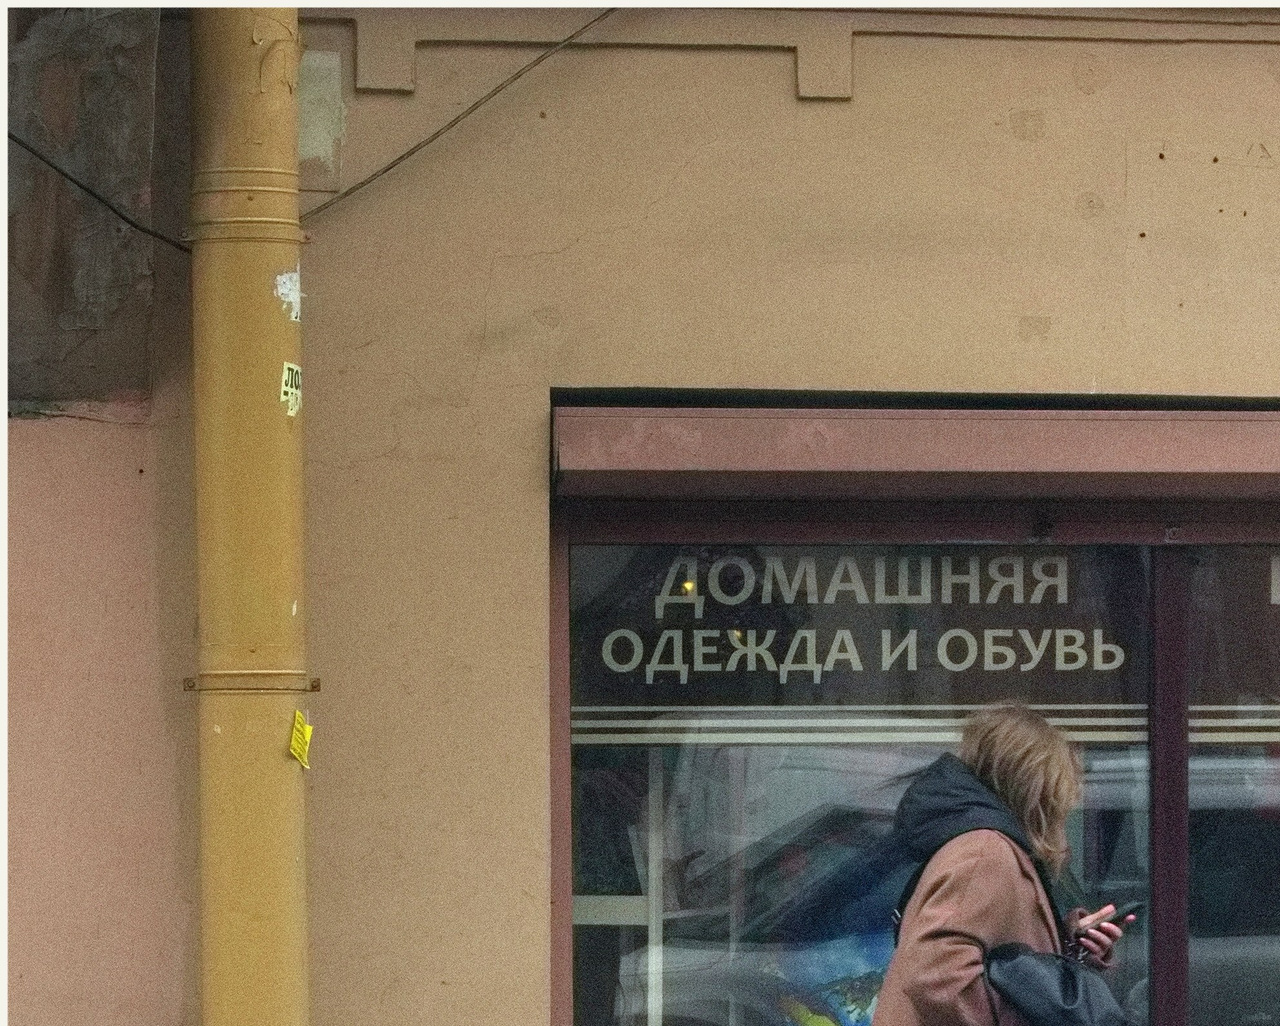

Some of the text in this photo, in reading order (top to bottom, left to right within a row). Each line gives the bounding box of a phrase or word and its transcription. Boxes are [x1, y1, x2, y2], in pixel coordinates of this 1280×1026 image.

[654, 555, 1070, 620] ДОМАШНЯЯ
[601, 627, 1126, 685] ОДЕЖДА И ОБУВЬ
